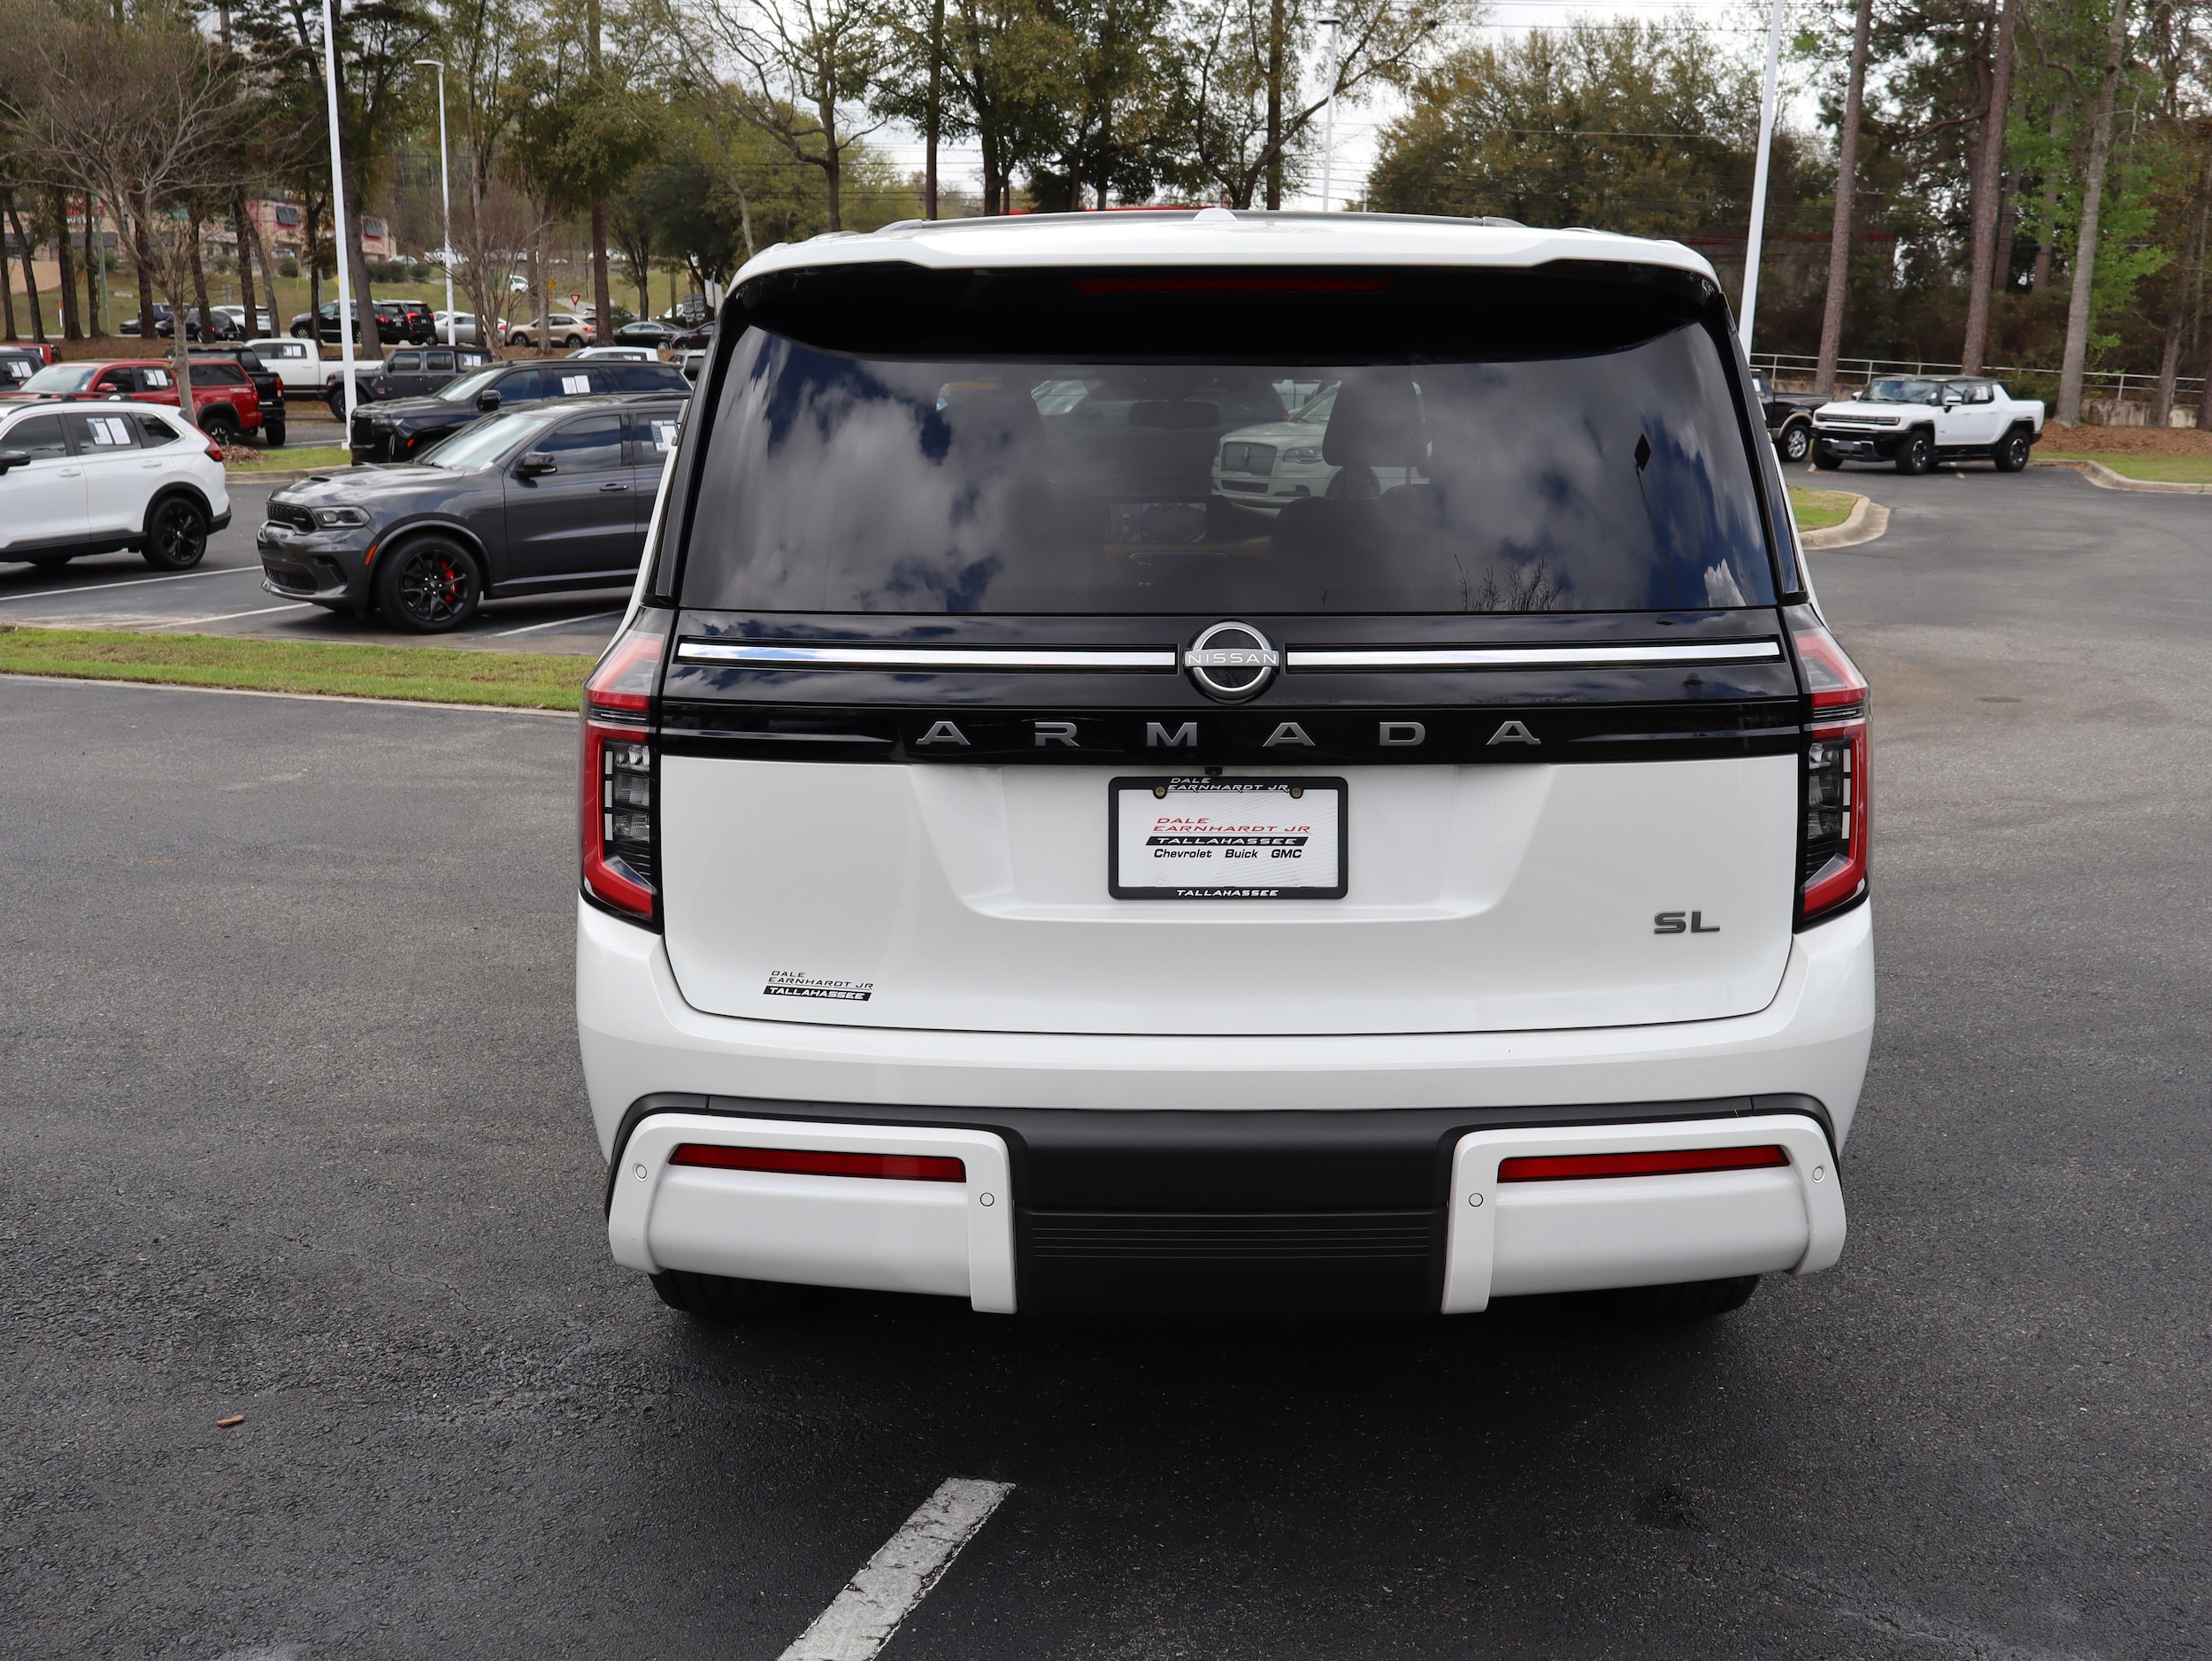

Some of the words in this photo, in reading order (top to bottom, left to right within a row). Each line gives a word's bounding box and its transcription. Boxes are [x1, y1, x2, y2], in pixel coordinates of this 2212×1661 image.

[1186, 650, 1279, 665] NISSAN
[915, 719, 1542, 748] ARMADA
[1154, 849, 1212, 858] Chevrolet
[1225, 849, 1258, 858] Buick
[1271, 849, 1302, 858] GMC
[1654, 910, 1721, 934] SL
[768, 977, 852, 988] EARNHARDT
[769, 987, 865, 1000] TALLAHASSEE
